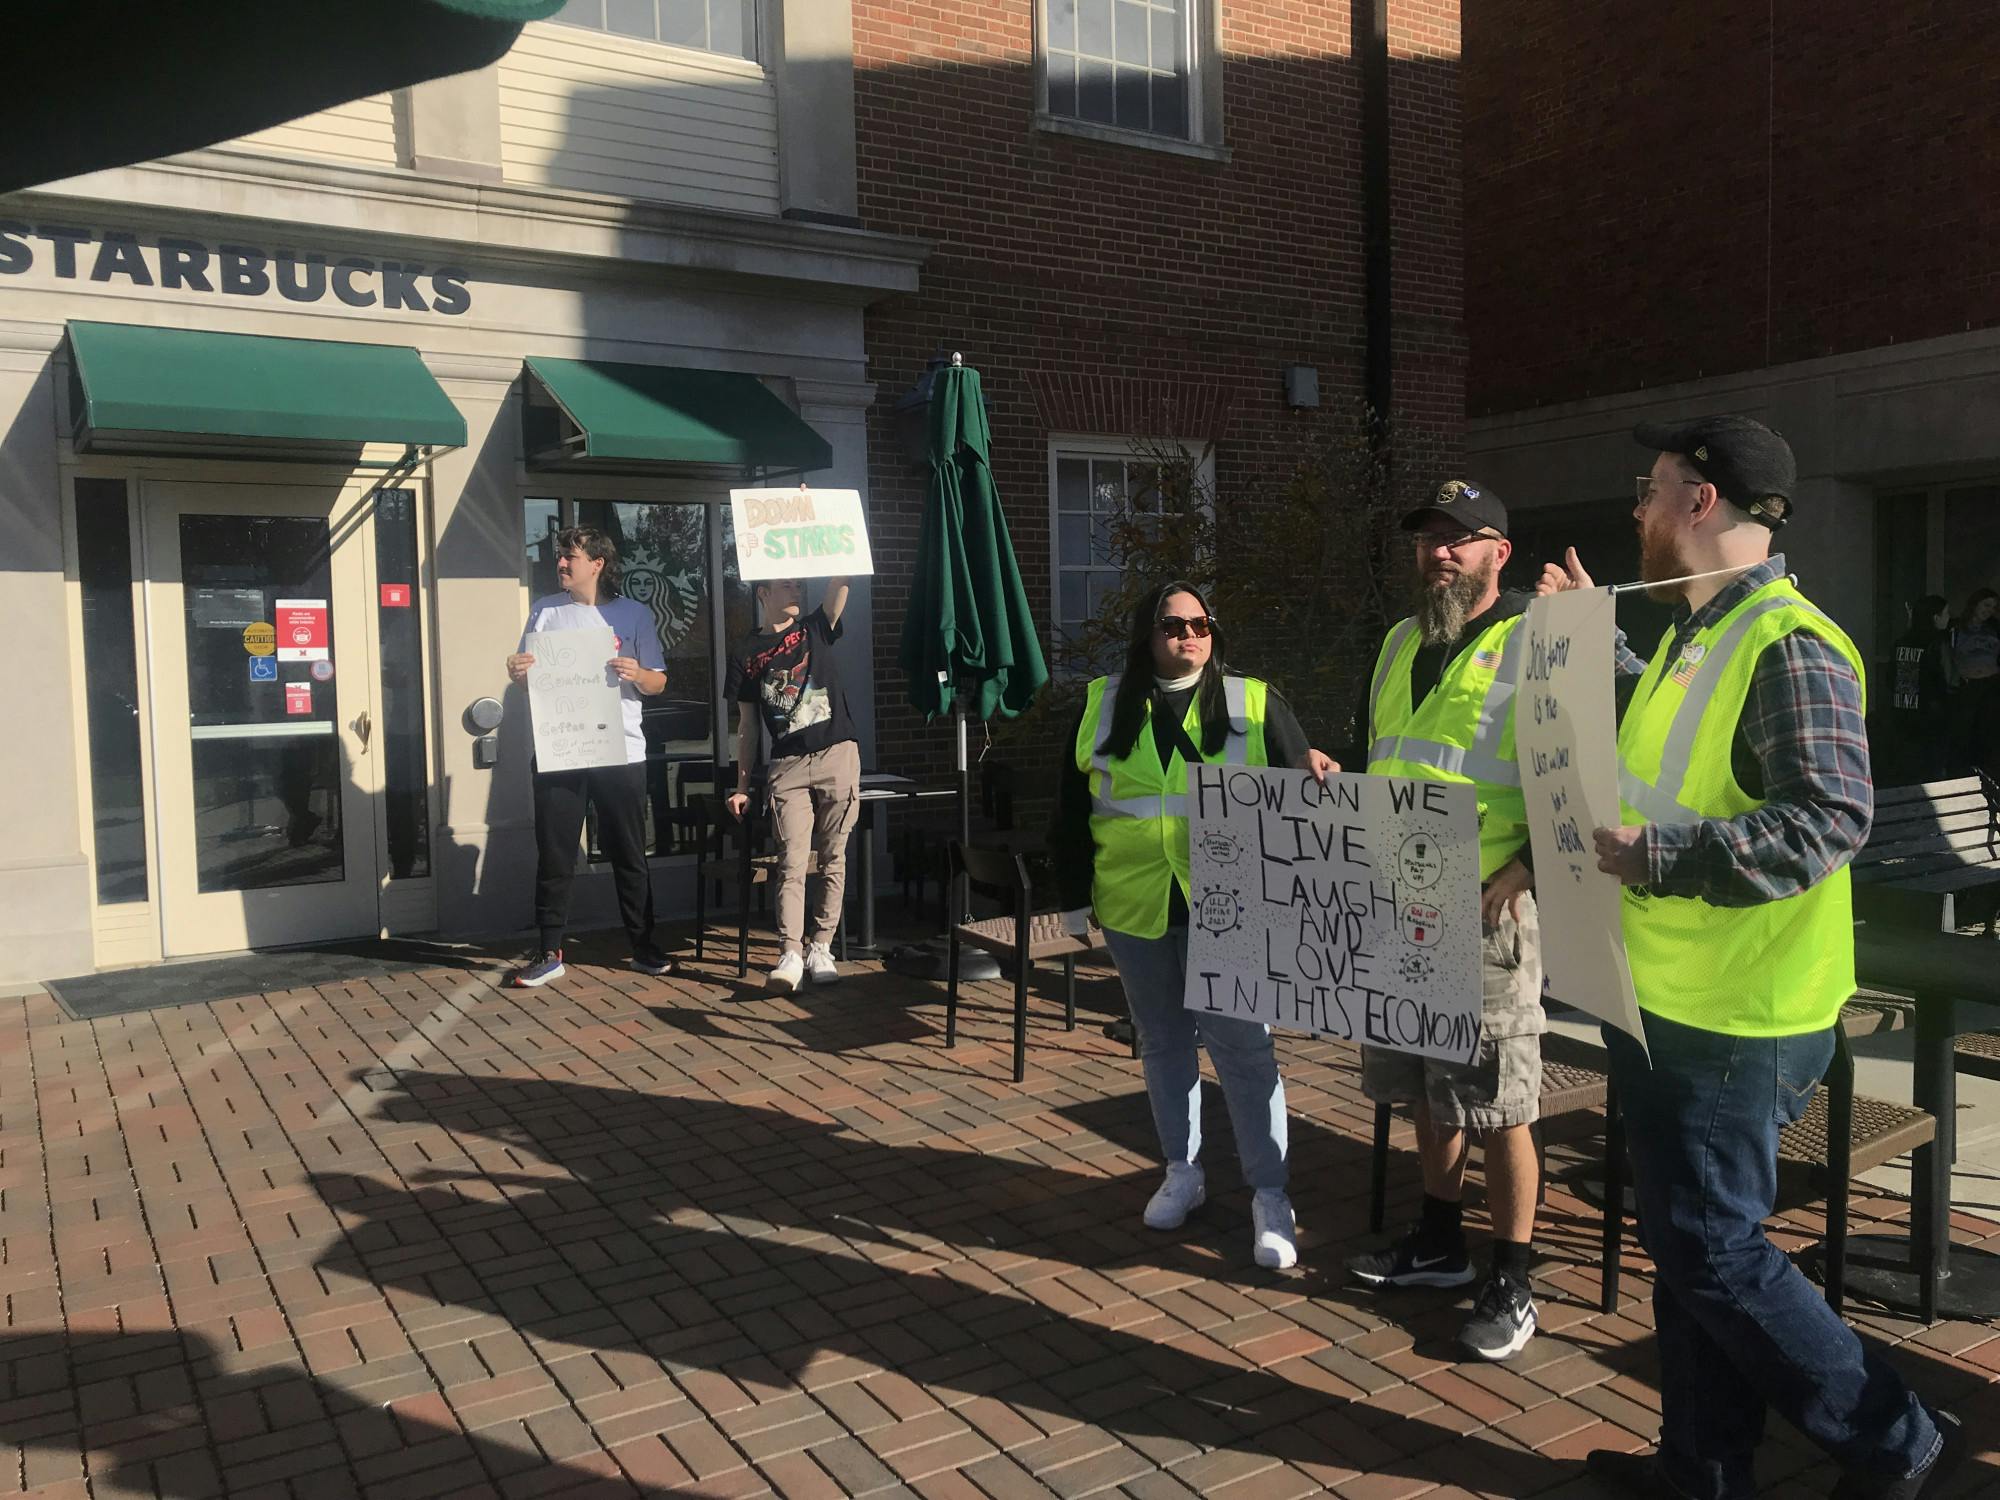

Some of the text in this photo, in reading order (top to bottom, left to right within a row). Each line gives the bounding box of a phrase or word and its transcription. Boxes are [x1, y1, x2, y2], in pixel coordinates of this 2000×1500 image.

[0, 221, 473, 315] STARBUCKS
[743, 495, 816, 529] DOWN
[244, 635, 274, 644] CAUTIO
[533, 636, 577, 668] No
[1197, 766, 1449, 819] HOW CAN WE
[1258, 809, 1371, 868] LIVE
[1261, 860, 1398, 931] LAUGH
[1300, 903, 1363, 952] AND
[1266, 928, 1385, 995] LOVE
[1200, 972, 1481, 1066] IN THIS ECONOMY
